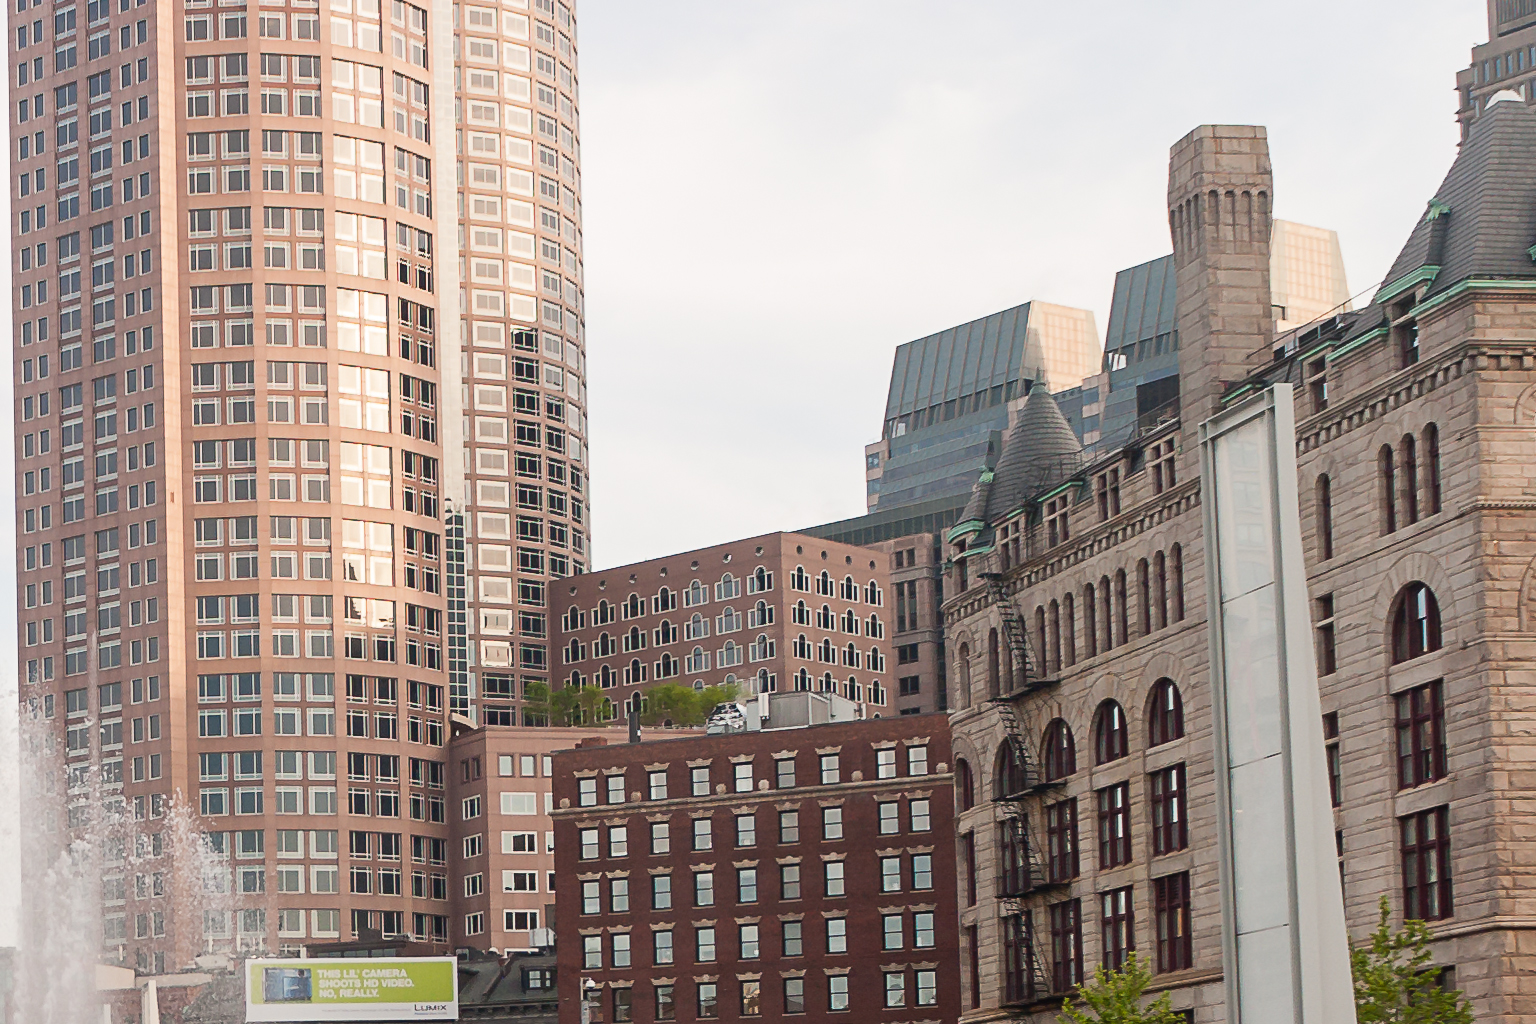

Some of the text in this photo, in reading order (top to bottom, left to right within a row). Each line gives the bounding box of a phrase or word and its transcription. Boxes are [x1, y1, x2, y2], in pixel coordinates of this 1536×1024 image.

[317, 968, 407, 978] THIS LIL' CAMERA
[319, 978, 415, 988] SHOOTS HD VIDEO.
[319, 988, 379, 999] NO, REALLY.
